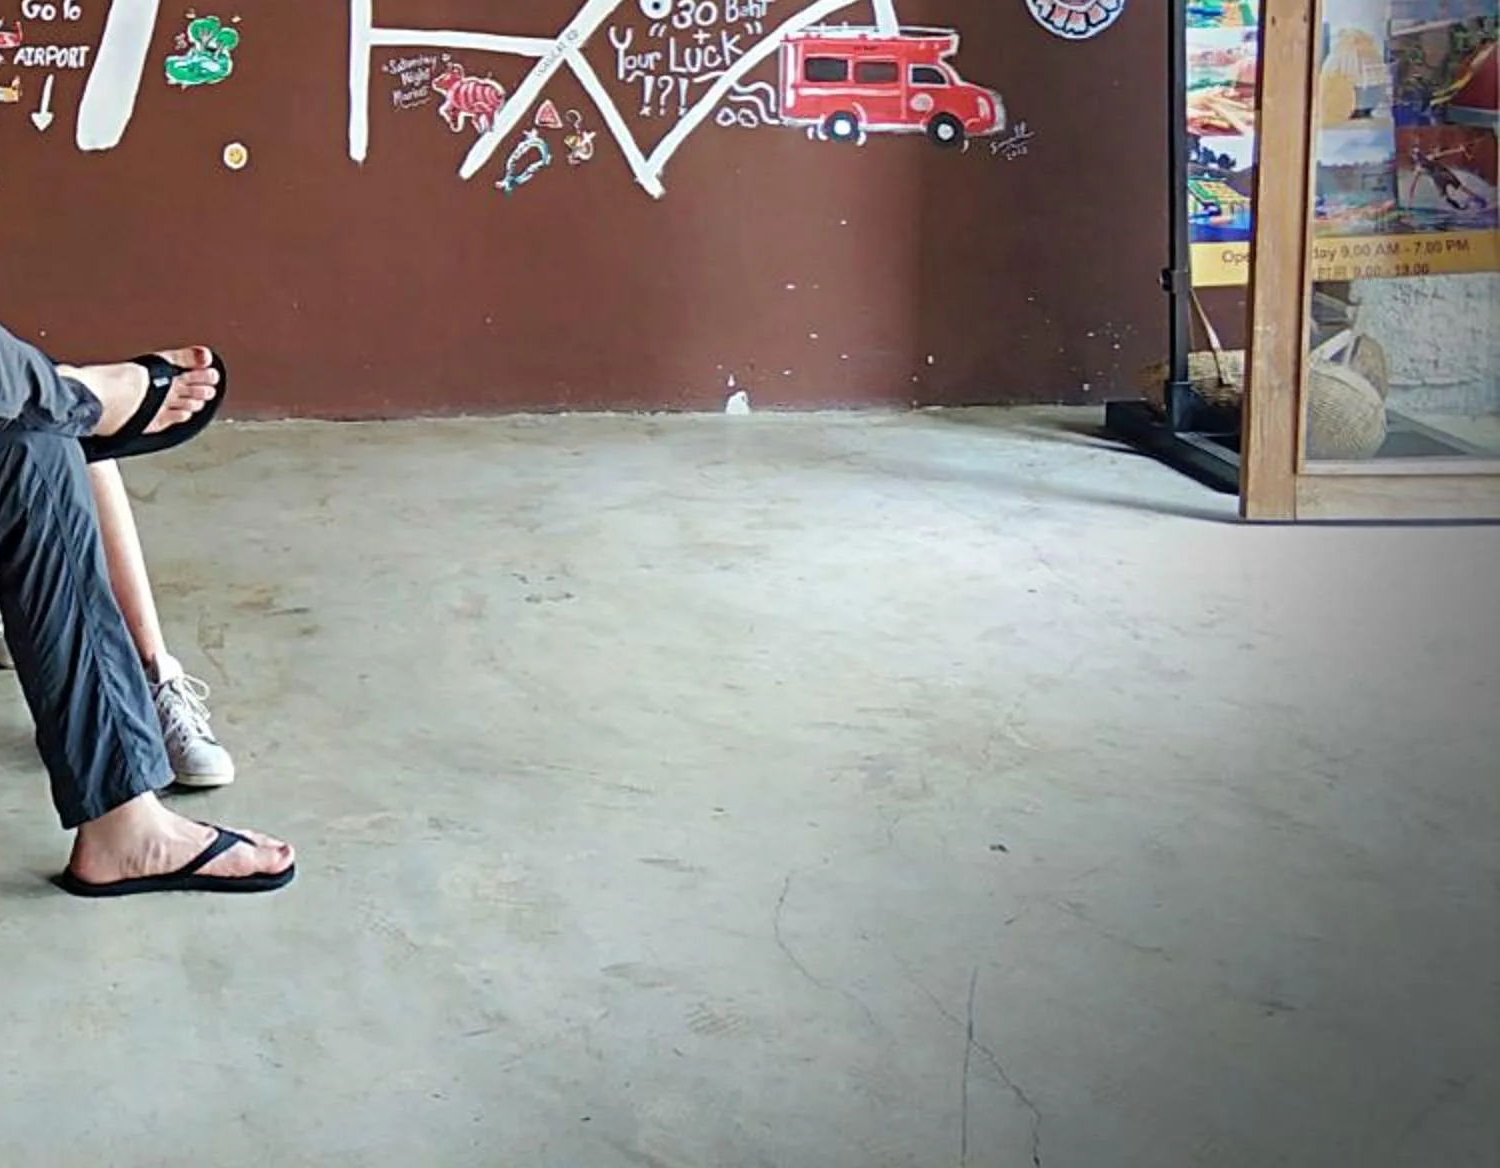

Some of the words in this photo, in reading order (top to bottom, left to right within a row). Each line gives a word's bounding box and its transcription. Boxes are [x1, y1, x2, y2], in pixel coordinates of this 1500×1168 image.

[13, 44, 91, 69] AIRPORT
[1374, 240, 1401, 257] AM
[1445, 238, 1471, 253] PM
